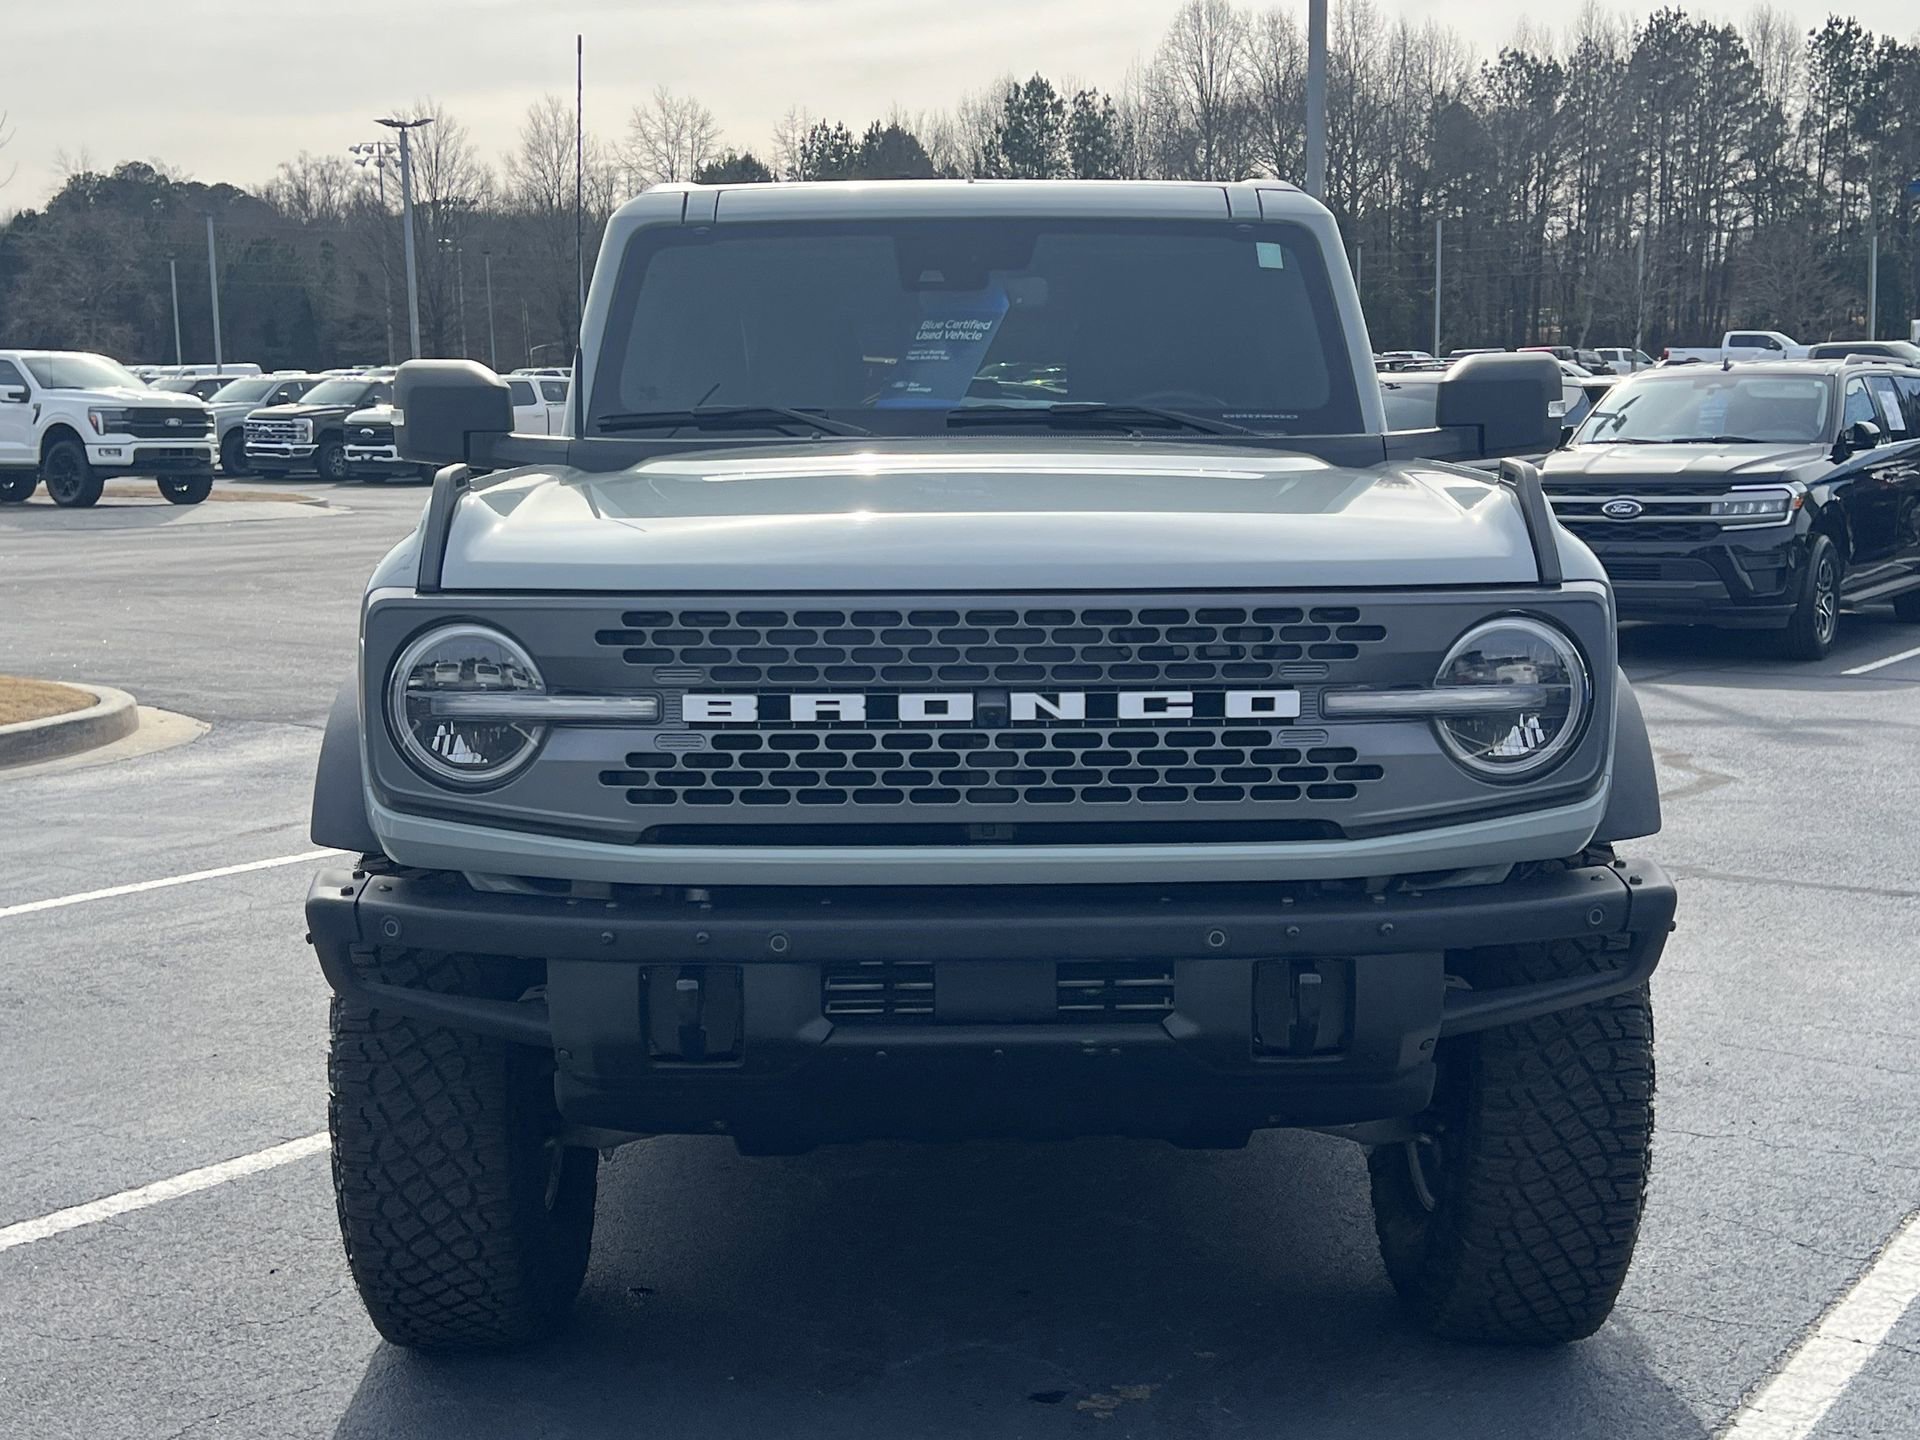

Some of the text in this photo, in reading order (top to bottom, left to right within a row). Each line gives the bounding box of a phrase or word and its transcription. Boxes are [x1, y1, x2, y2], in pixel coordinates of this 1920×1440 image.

[921, 319, 993, 330] Blue Certified
[916, 330, 983, 340] Used Vehicle
[682, 690, 1300, 722] BRONCO
